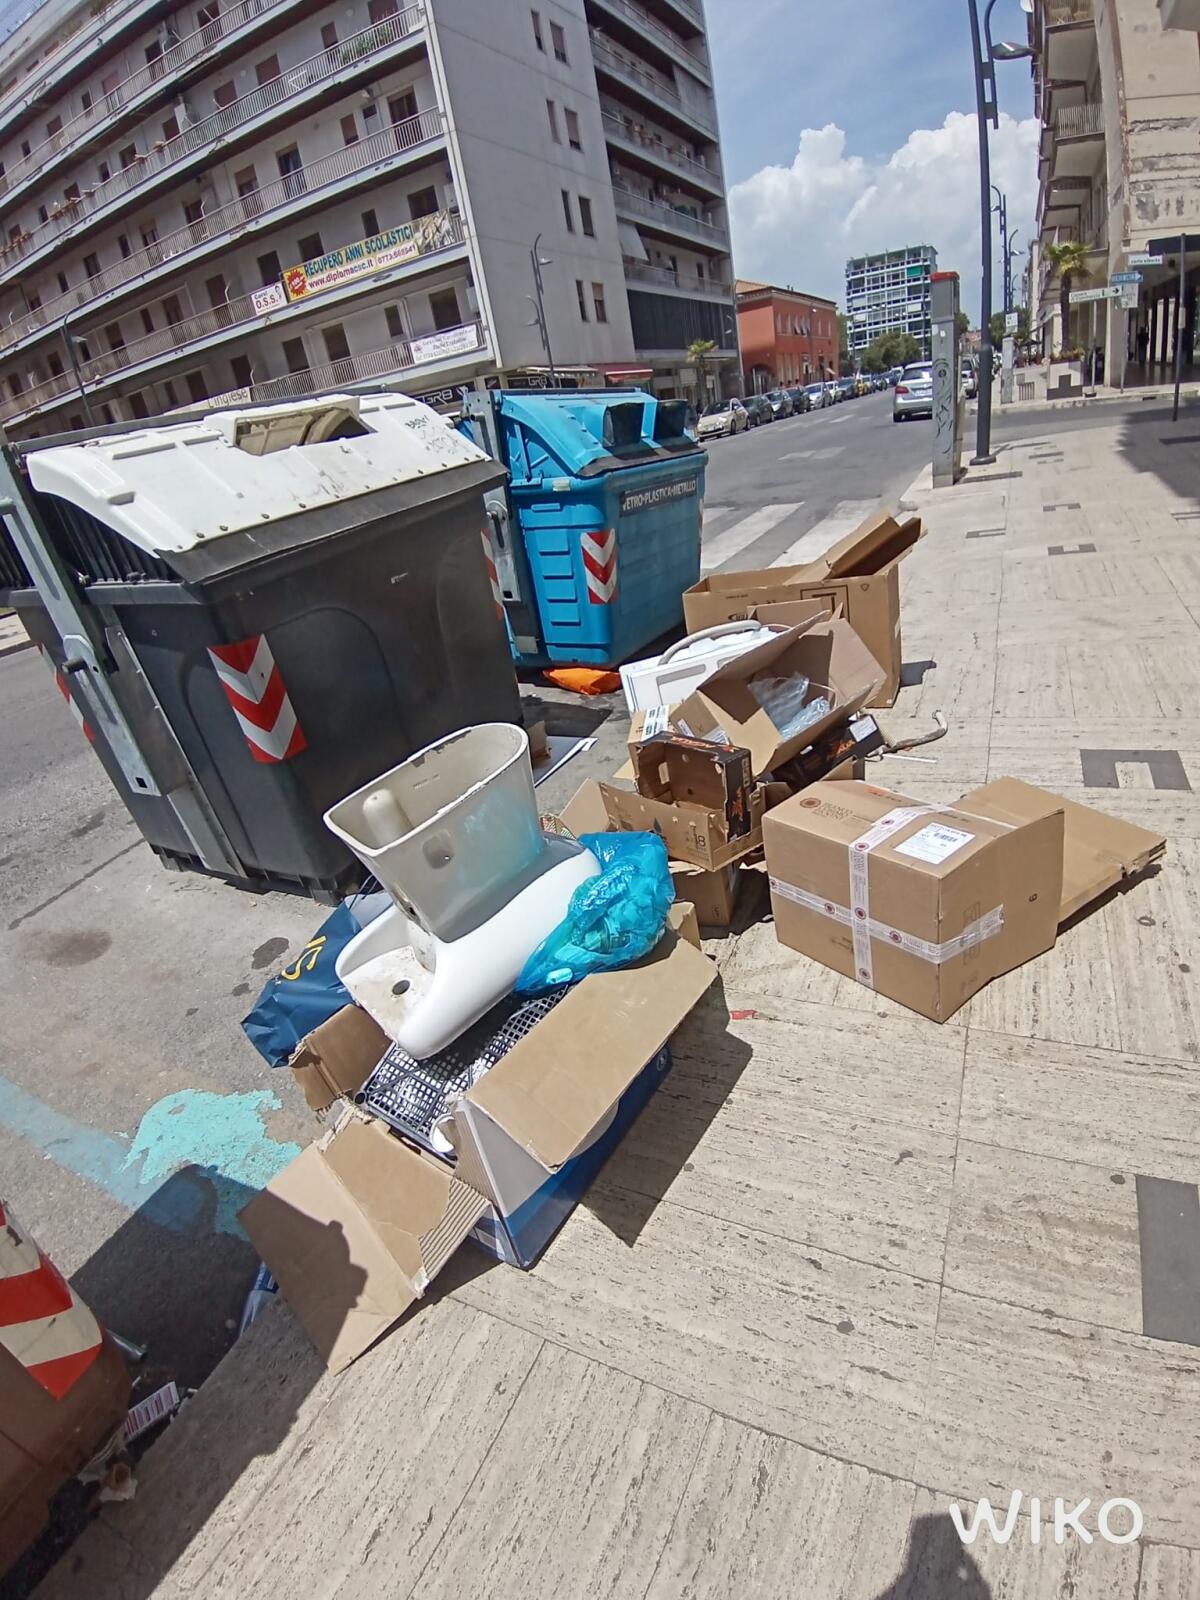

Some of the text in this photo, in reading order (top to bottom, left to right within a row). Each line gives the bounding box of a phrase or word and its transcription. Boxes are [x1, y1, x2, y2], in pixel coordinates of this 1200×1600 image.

[304, 226, 414, 277] RECUPERO ANNI SCOLASTICI
[256, 293, 279, 310] O.S.S.
